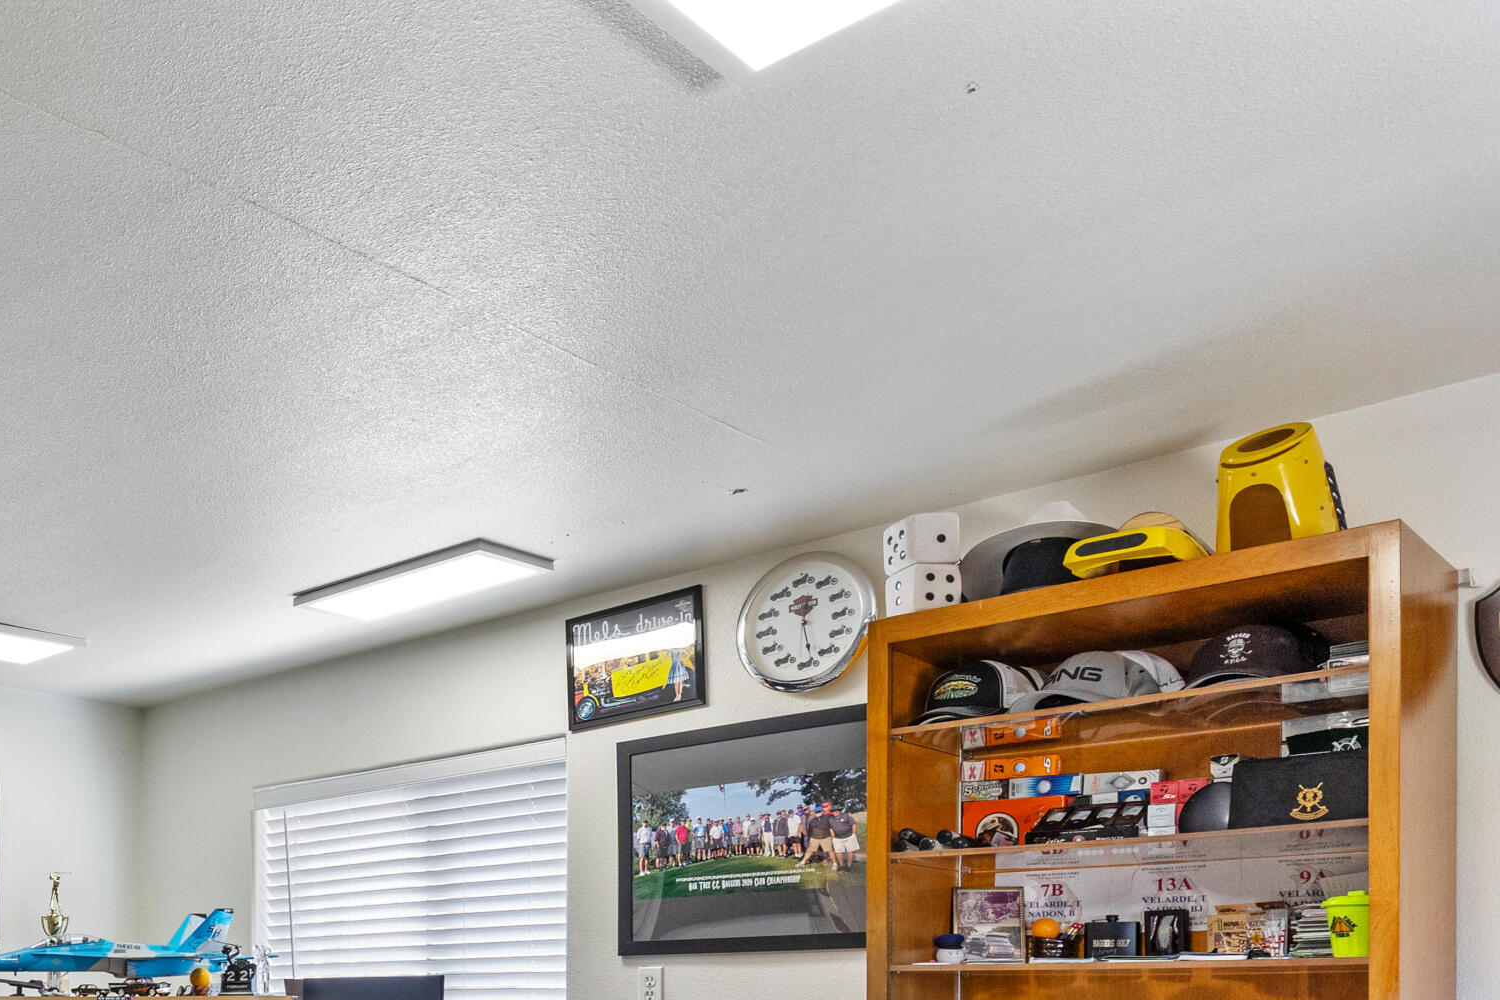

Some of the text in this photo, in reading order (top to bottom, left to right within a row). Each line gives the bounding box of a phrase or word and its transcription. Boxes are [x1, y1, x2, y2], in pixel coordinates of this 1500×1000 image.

[573, 612, 695, 646] Mels drive-in
[1300, 870, 1326, 884] 9A
[1041, 884, 1063, 896] 7B
[1156, 878, 1192, 892] 13A
